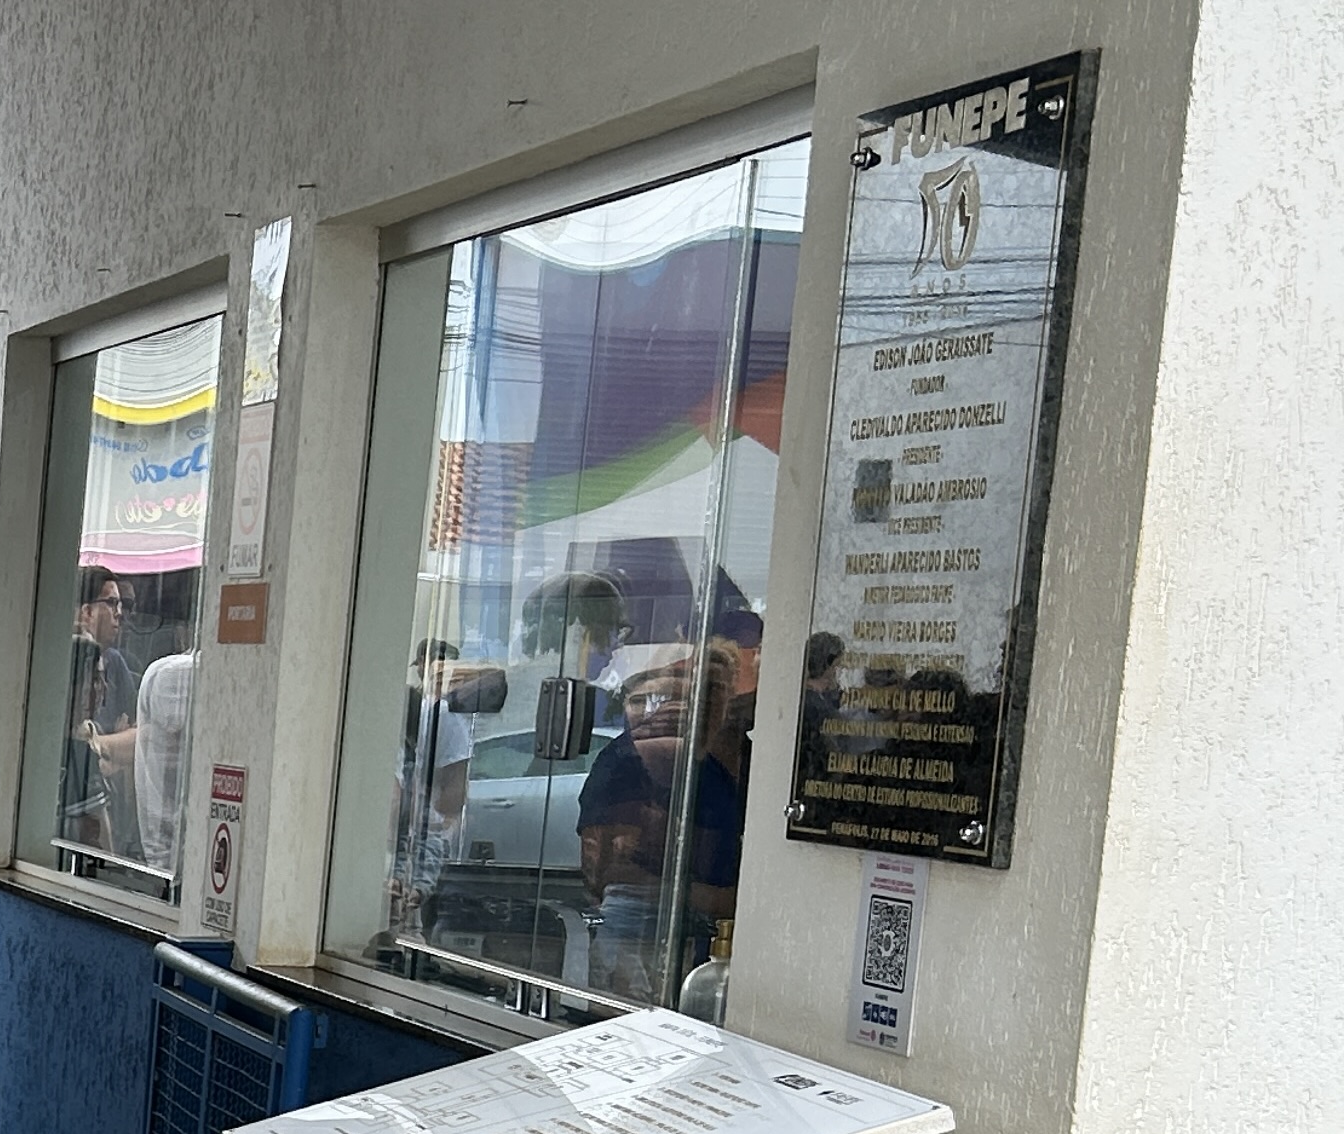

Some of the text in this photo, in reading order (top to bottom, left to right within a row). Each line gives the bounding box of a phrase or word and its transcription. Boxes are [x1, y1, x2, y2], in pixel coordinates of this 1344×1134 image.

[892, 77, 1030, 165] FUNEPE
[873, 346, 907, 371] EDISON
[935, 332, 994, 362] GERAISSATE
[905, 408, 957, 434] APARECIDO
[958, 401, 1006, 429] DONZELLI
[889, 550, 942, 573] APARECIDO
[943, 548, 981, 572] BASTOS
[918, 620, 958, 643] BORGES
[900, 757, 913, 780] DE
[913, 758, 954, 783] ALMEIDA
[211, 802, 240, 823] ENTRADA
[880, 827, 890, 841] DE
[910, 830, 921, 845] DE
